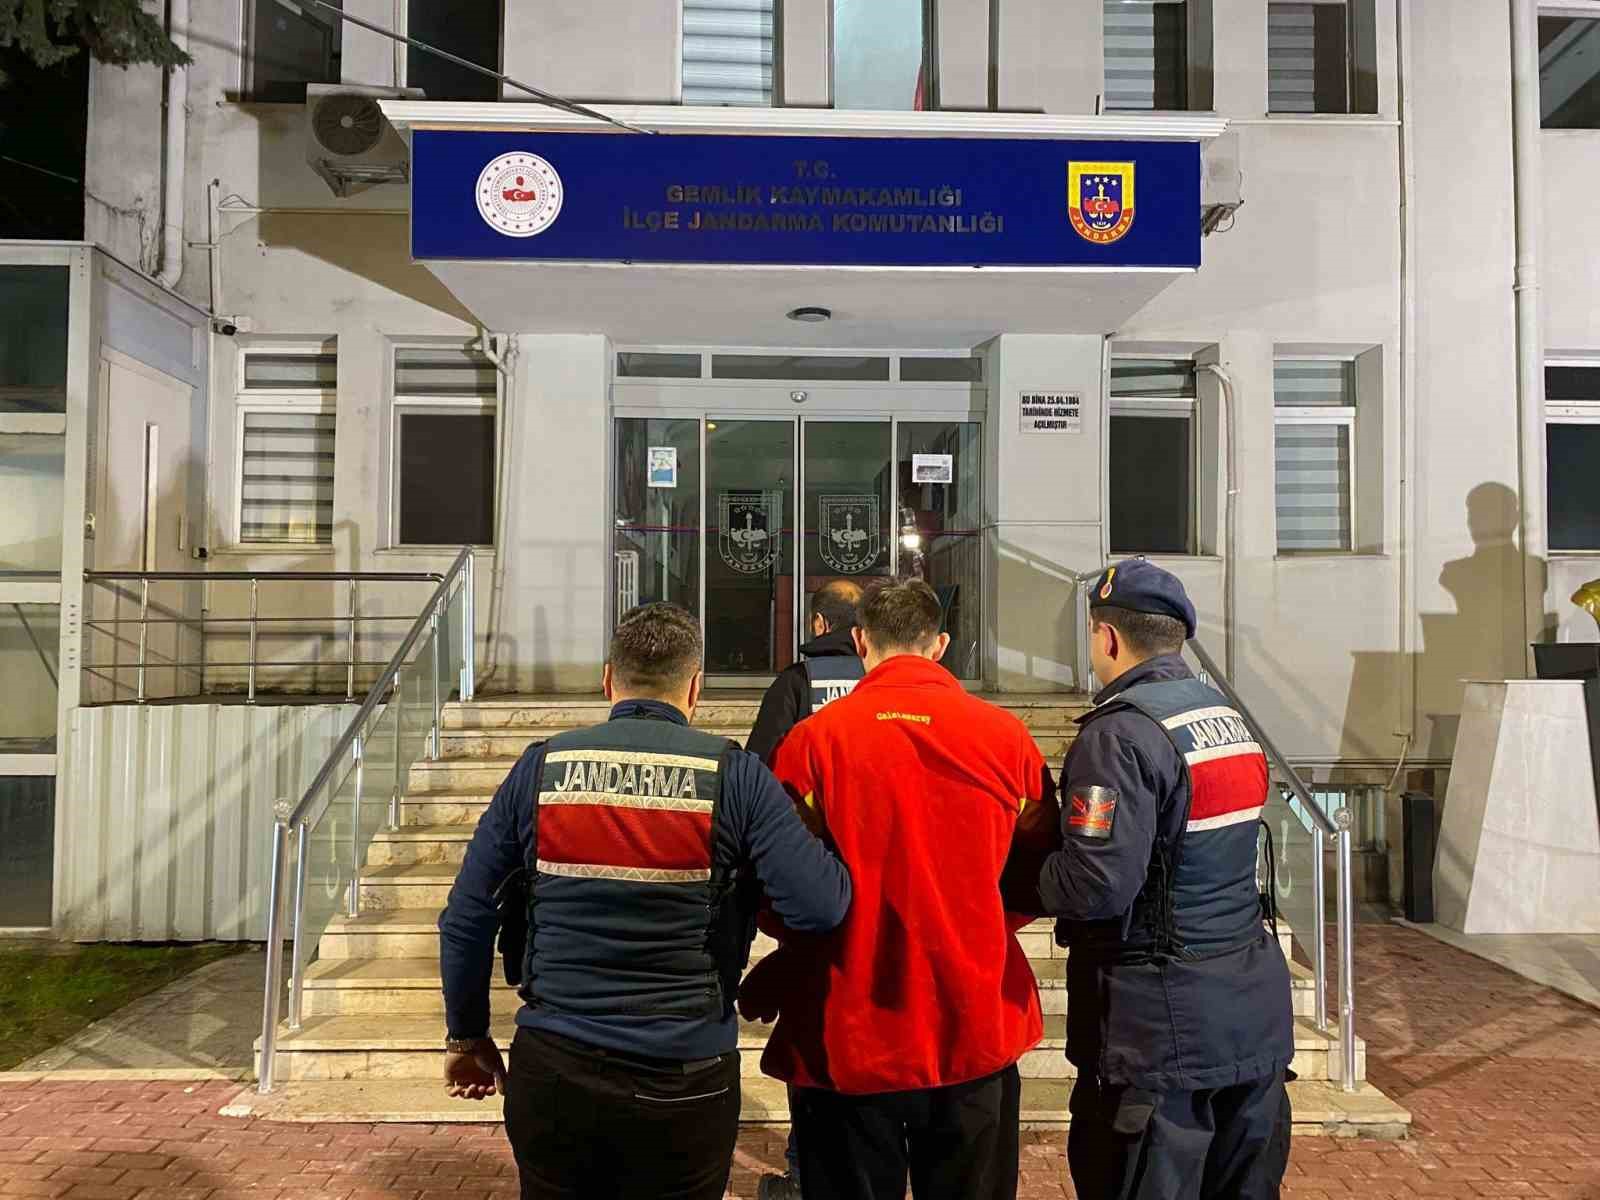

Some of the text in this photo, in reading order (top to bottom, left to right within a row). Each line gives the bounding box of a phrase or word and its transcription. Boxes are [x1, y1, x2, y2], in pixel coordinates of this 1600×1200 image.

[665, 180, 963, 207] GEMLİK KAYMAKAMLIĞI
[623, 206, 1005, 234] İLÇE JANDARMA KOMUTANLIĞI
[1072, 214, 1131, 241] JANDARMA
[554, 761, 698, 799] JANDARMA
